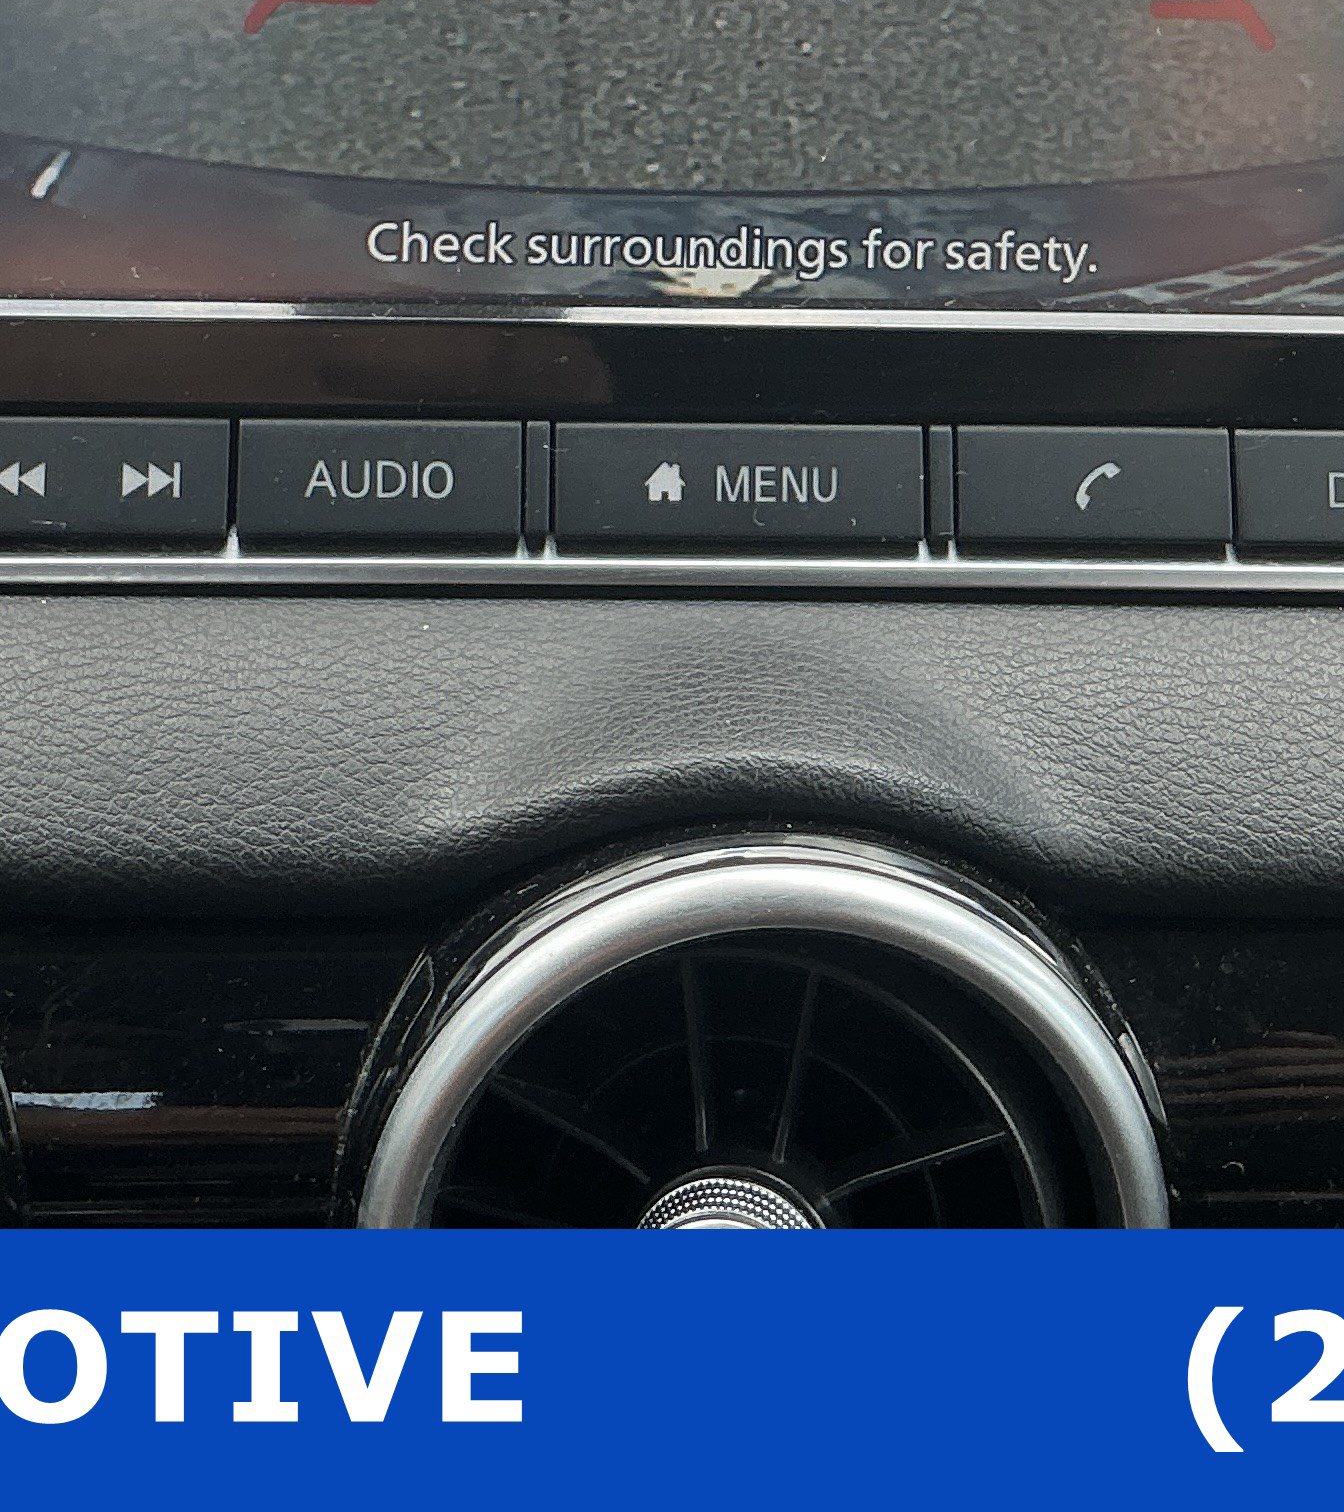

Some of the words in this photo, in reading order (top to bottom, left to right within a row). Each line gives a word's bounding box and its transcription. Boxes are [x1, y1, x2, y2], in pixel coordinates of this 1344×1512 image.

[366, 220, 513, 265] Check
[526, 225, 848, 280] surroundings
[861, 227, 935, 271] for
[944, 229, 1099, 284] safety.
[304, 459, 455, 500] AUDIO
[715, 464, 839, 504] MENU
